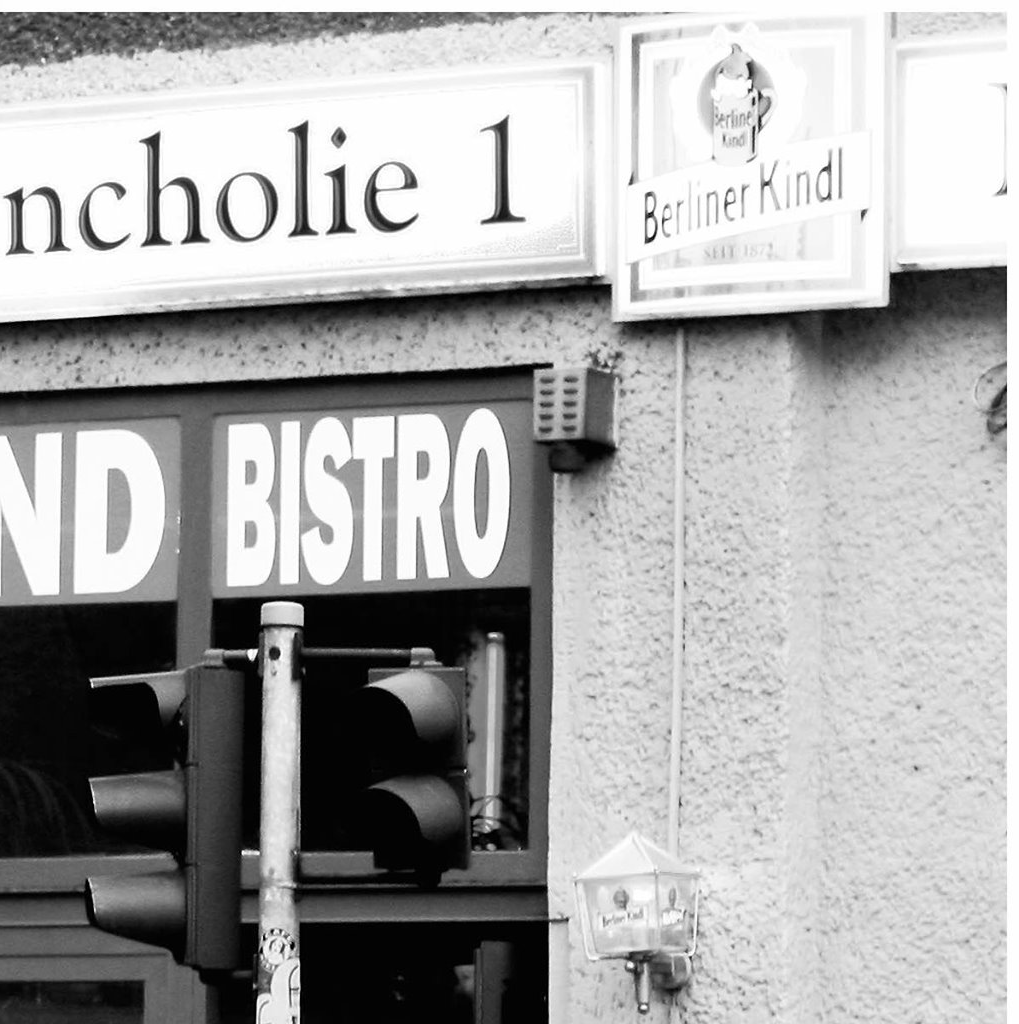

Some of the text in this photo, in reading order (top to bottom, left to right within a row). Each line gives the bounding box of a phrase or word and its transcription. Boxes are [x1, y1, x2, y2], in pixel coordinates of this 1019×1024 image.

[478, 114, 526, 226] 1
[644, 147, 843, 245] Berliner Kindl
[226, 407, 512, 588] BISTRO
